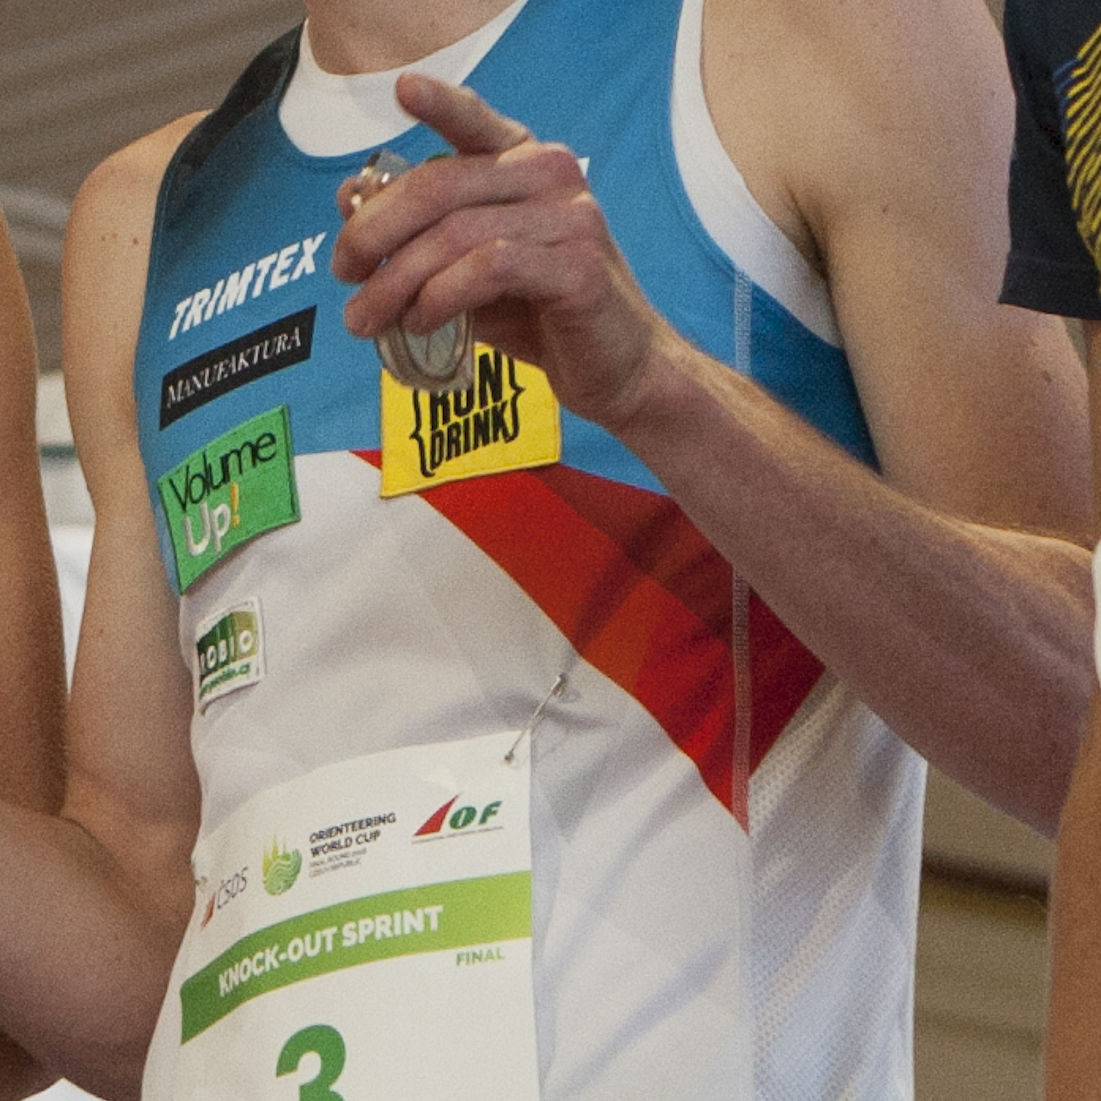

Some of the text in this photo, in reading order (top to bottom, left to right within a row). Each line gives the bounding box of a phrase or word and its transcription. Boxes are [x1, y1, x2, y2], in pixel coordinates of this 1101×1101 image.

[168, 232, 327, 341] TRIMTEX
[166, 326, 302, 408] MANUFAKTURA
[169, 432, 277, 513] Volume
[430, 399, 509, 470] DRINK
[184, 481, 240, 557] Up!
[309, 812, 397, 843] ORIENTEERING
[310, 830, 381, 858] WORLD CUP
[218, 905, 444, 997] KNOCK-OUT SPRINT
[456, 949, 505, 967] FINAL
[276, 1023, 347, 1101] 3
